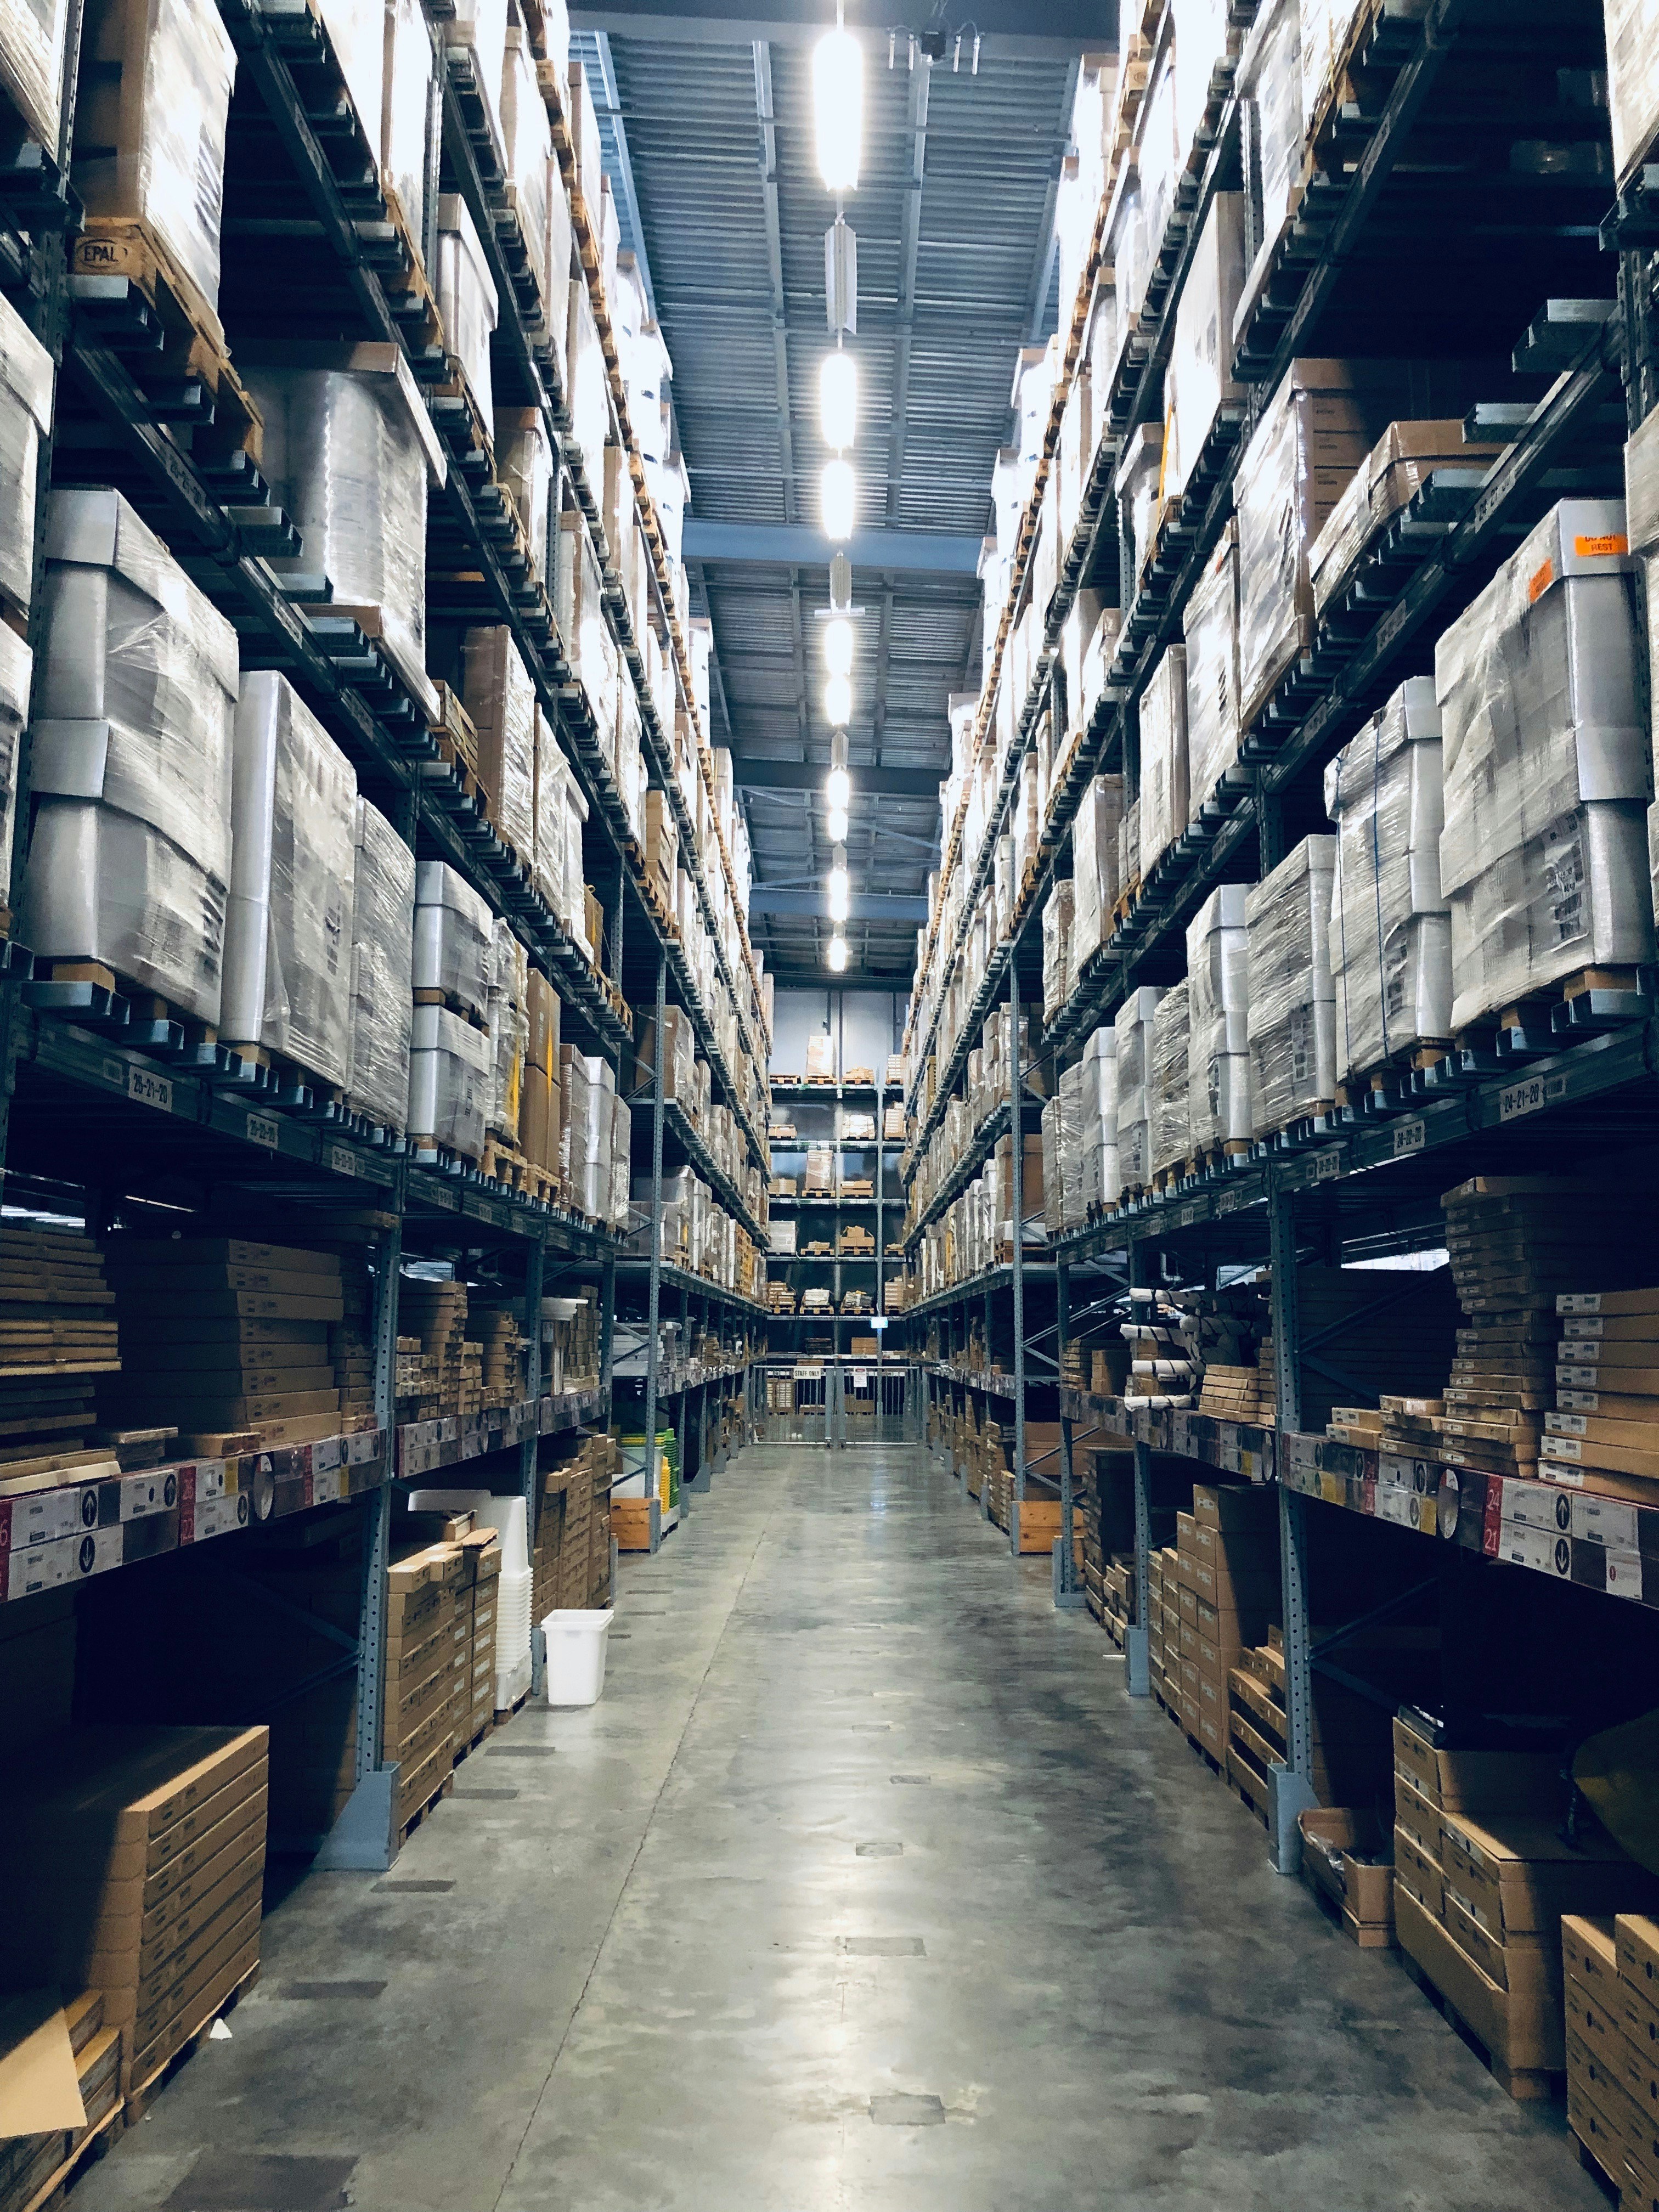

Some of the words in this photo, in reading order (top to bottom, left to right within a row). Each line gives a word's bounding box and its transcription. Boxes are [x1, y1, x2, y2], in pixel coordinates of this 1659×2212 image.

[84, 246, 119, 262] EPAL
[1505, 1082, 1539, 1113] 24-21-20
[1486, 1488, 1500, 1510] 24
[0, 1519, 8, 1547] 6
[1485, 1528, 1497, 1552] 21
